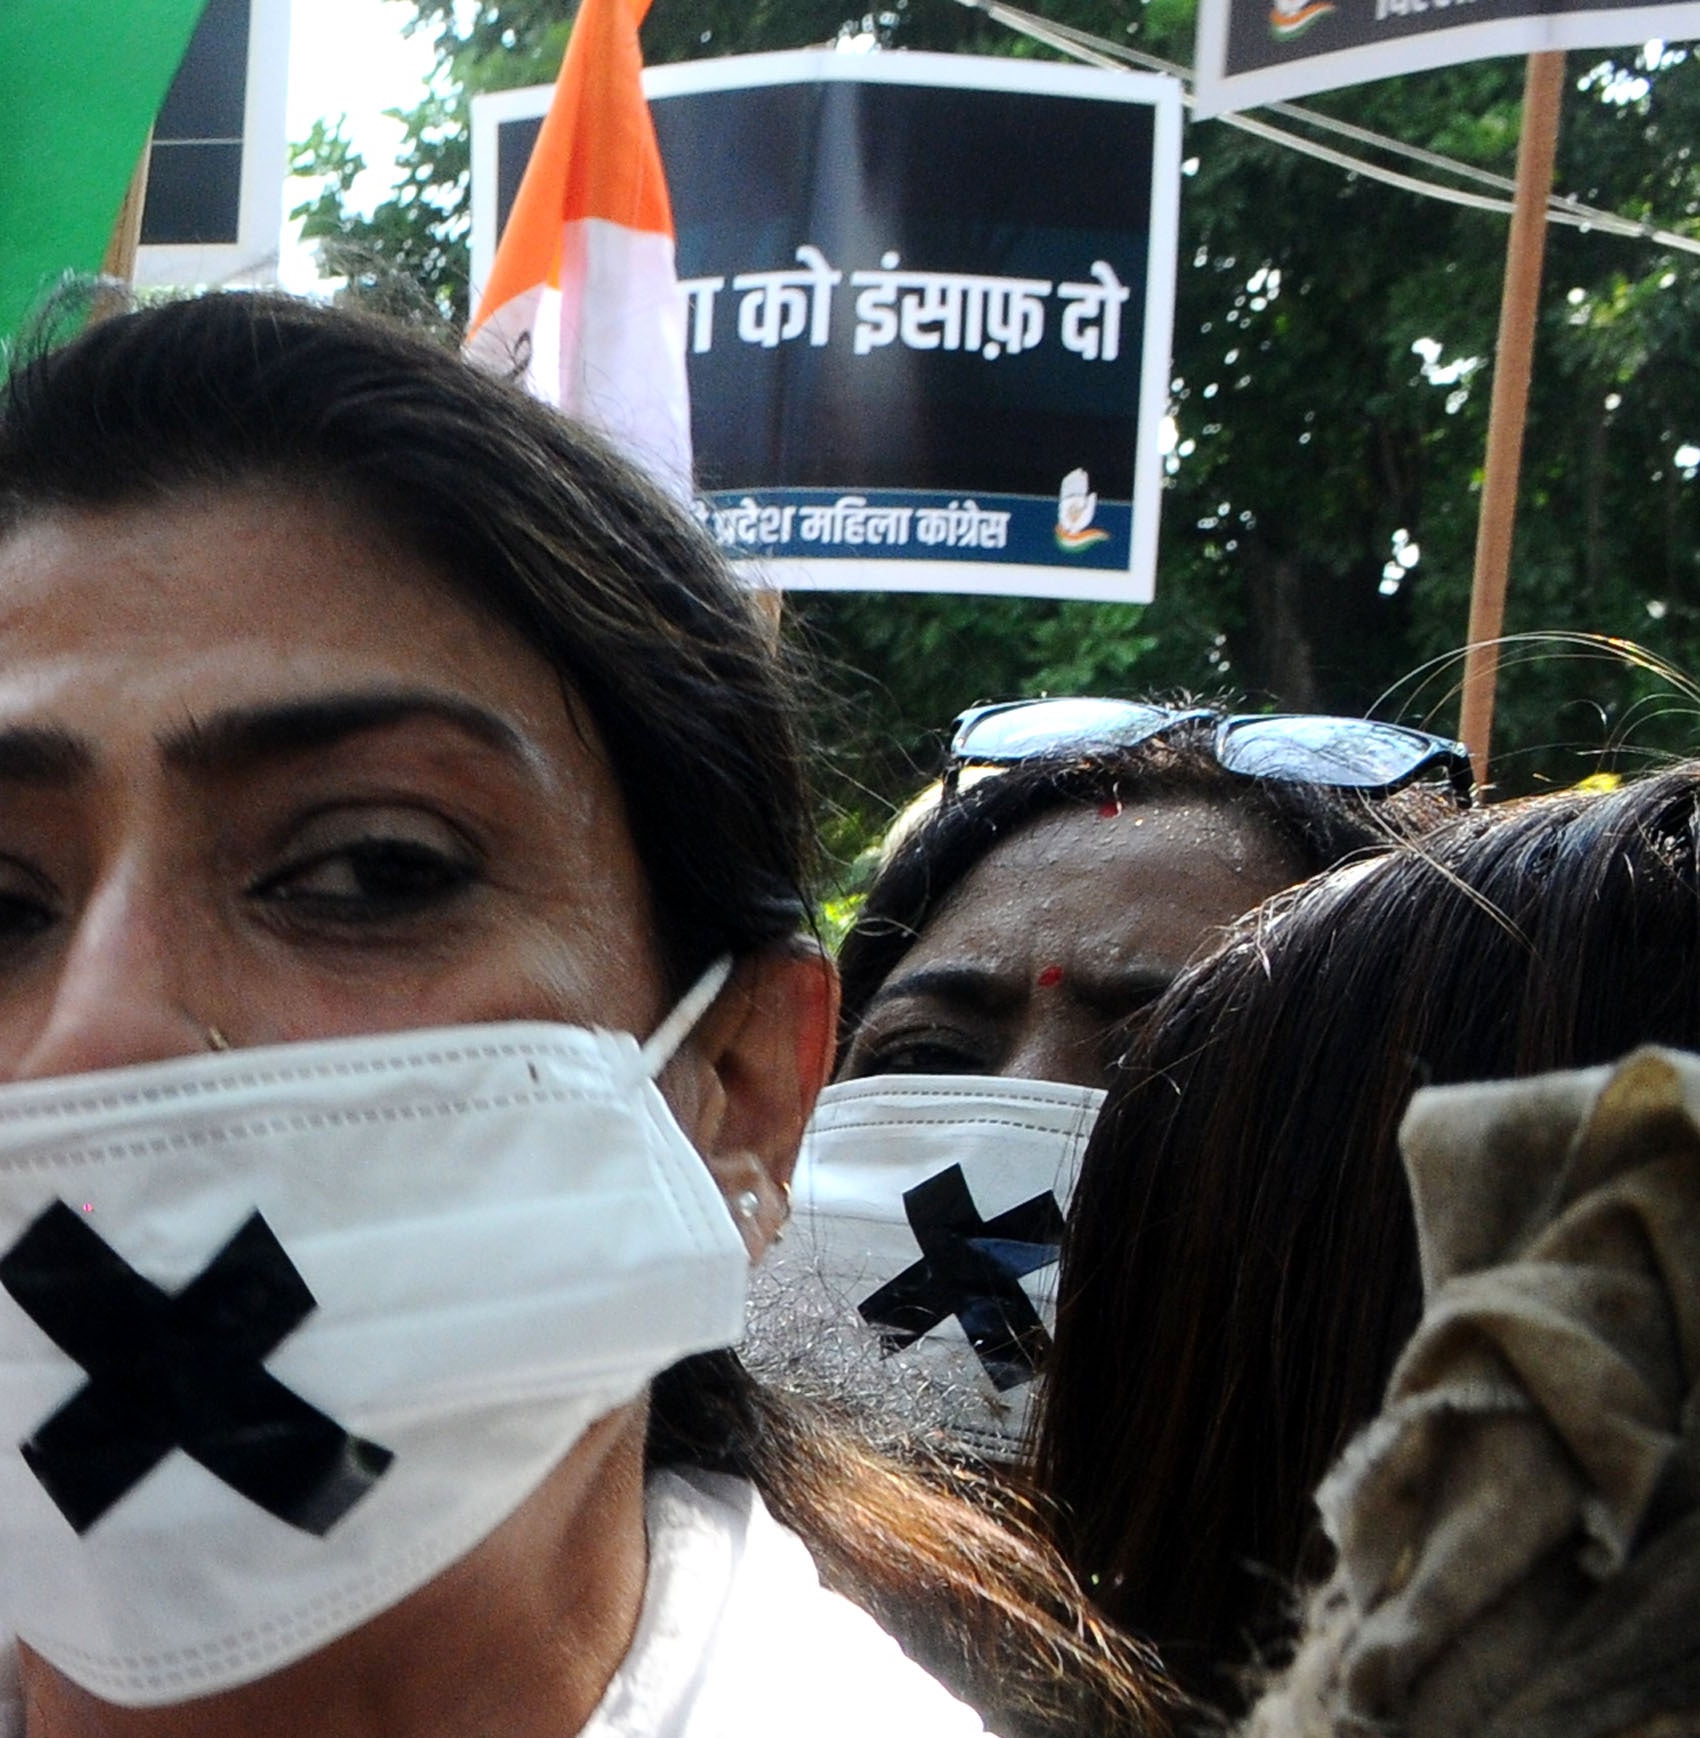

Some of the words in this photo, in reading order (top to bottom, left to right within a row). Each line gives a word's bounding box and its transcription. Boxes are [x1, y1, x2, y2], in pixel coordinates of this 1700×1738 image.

[733, 244, 842, 348] को
[850, 251, 1052, 362] इंसाफ़
[1057, 260, 1130, 362] दो
[711, 497, 797, 548] प्रदेश
[799, 495, 913, 546] महिला
[915, 499, 1011, 549] कांग्रेस
